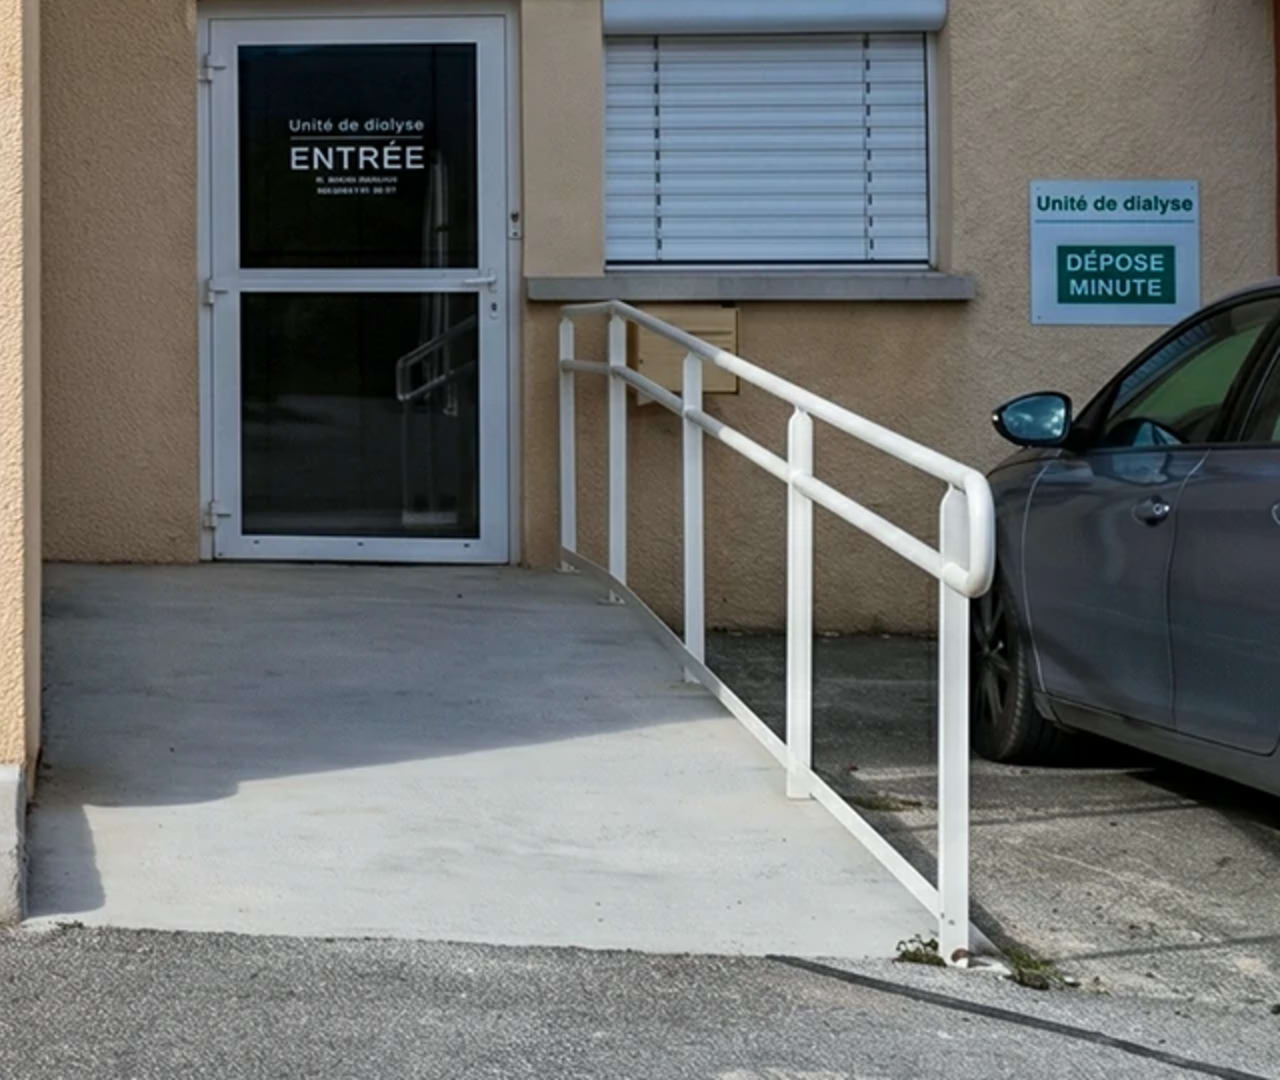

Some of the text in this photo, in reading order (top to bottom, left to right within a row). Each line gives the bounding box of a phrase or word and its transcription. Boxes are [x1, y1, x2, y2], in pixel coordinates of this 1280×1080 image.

[289, 118, 333, 132] Unité
[338, 119, 359, 131] de
[290, 139, 425, 170] ENTRÉE
[1037, 195, 1193, 215] Unité de dialyse
[1066, 249, 1165, 272] DÉPOSE
[1069, 278, 1162, 297] MINUTE
